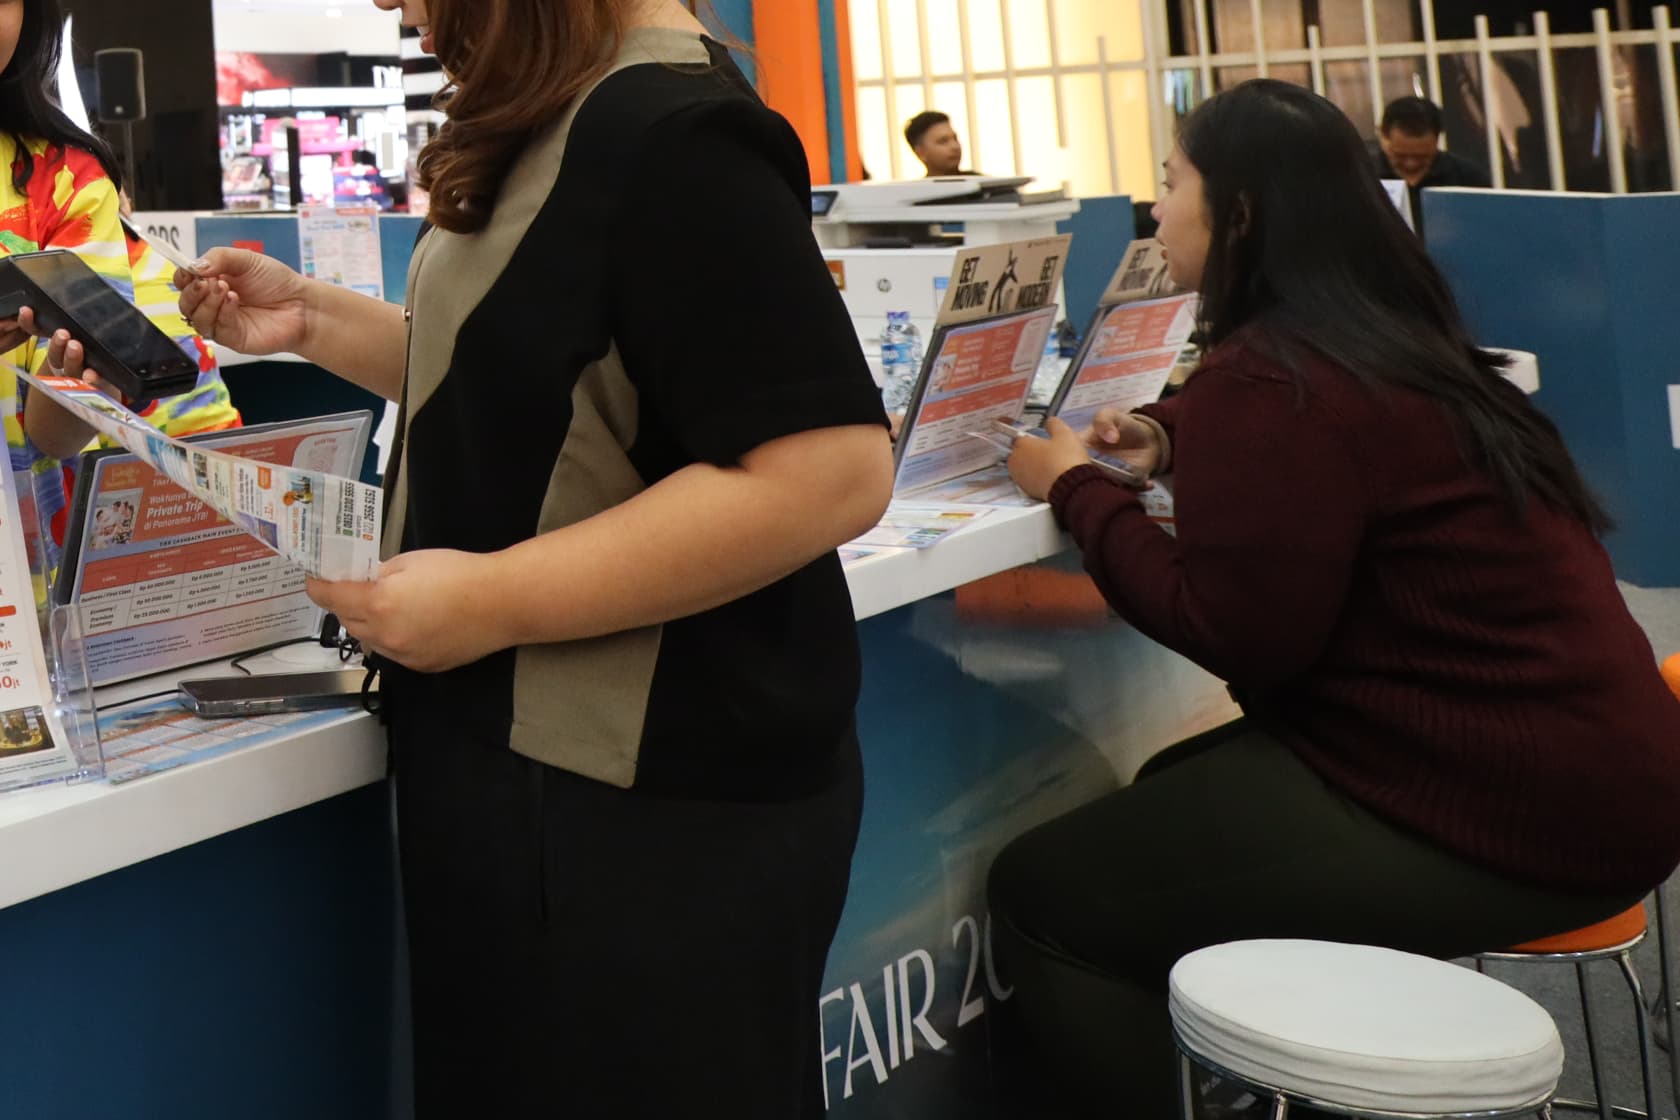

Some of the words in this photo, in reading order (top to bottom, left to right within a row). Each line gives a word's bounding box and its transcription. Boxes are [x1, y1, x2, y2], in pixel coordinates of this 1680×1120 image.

[147, 504, 183, 519] Private
[185, 501, 203, 513] Trip
[819, 949, 948, 1111] FAIR
